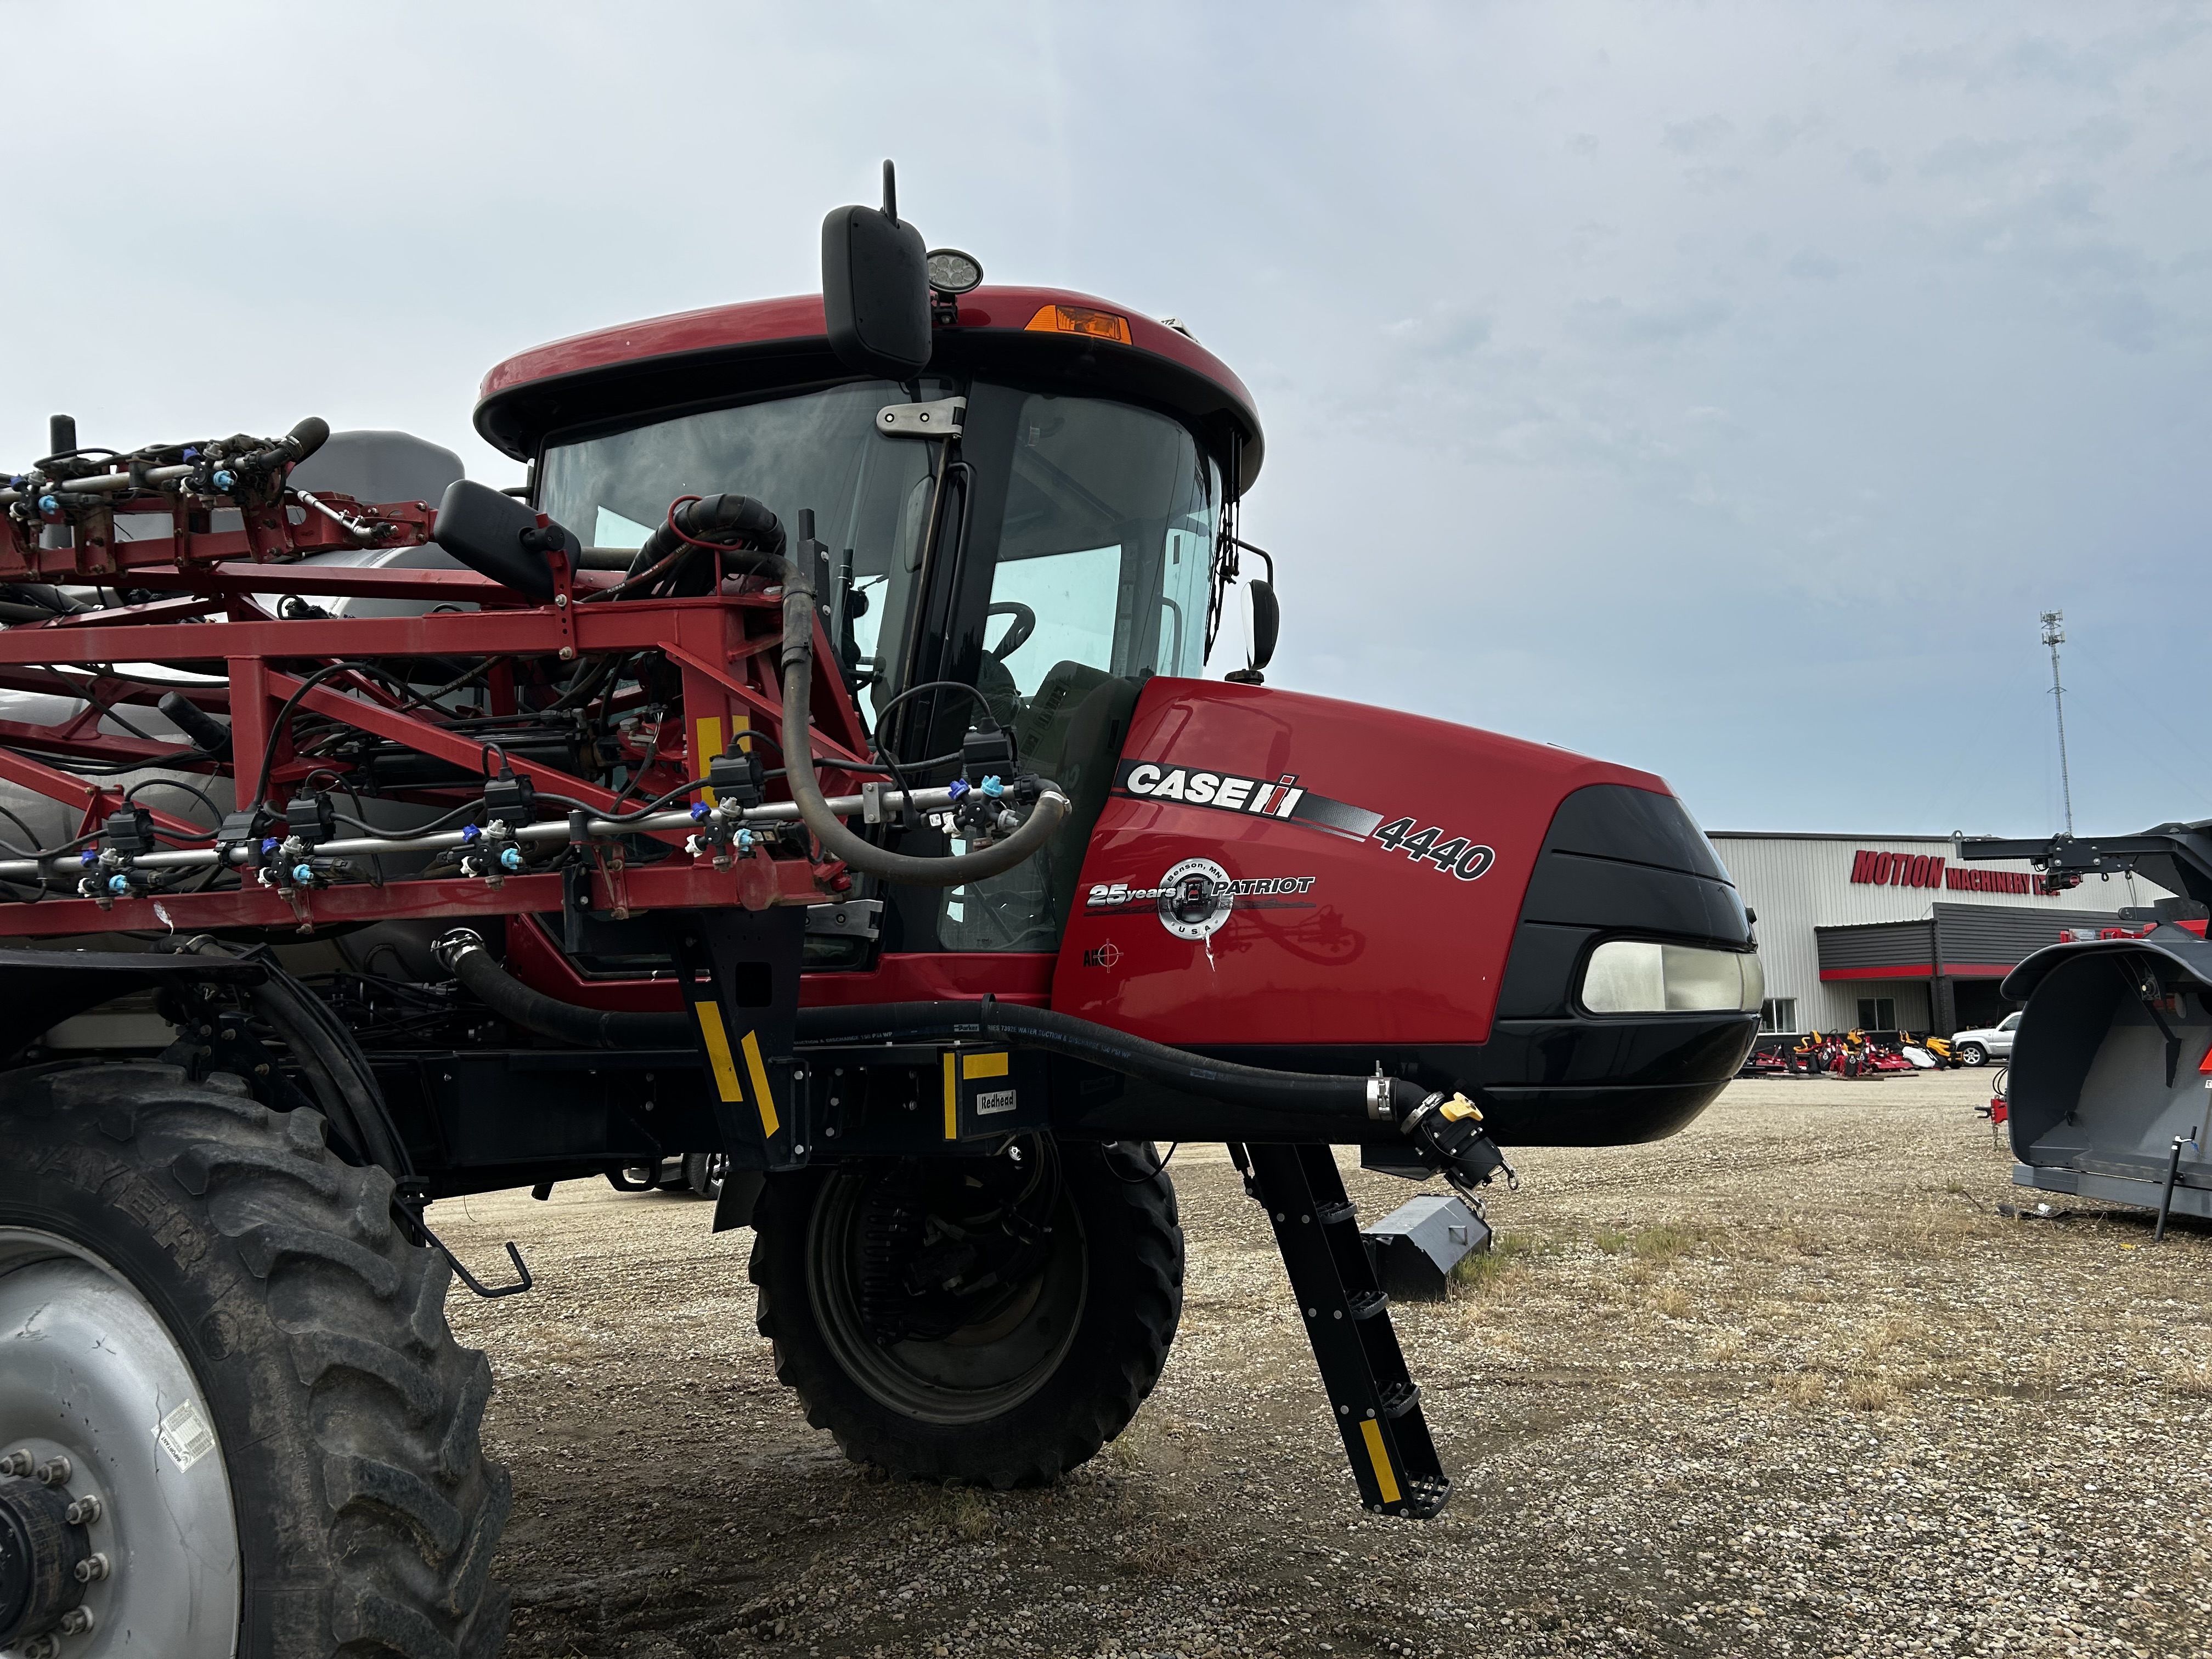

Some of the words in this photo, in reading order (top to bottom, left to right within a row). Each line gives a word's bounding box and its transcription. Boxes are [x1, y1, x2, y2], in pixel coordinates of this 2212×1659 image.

[1127, 764, 1255, 809] CASE
[1372, 816, 1496, 881] 4440
[1209, 866, 1222, 879] MN
[1210, 876, 1317, 897] PATRIOT
[1850, 850, 1946, 889] MOTION
[1945, 867, 2031, 895] MACHINERY
[1001, 1025, 1017, 1033] 7392E
[1018, 1026, 1037, 1036] WATER
[1038, 1029, 1063, 1041] SUCTION
[1068, 1036, 1099, 1050] DISCHARGE
[1111, 1047, 1121, 1056] PSI
[981, 1091, 1013, 1109] Redhead
